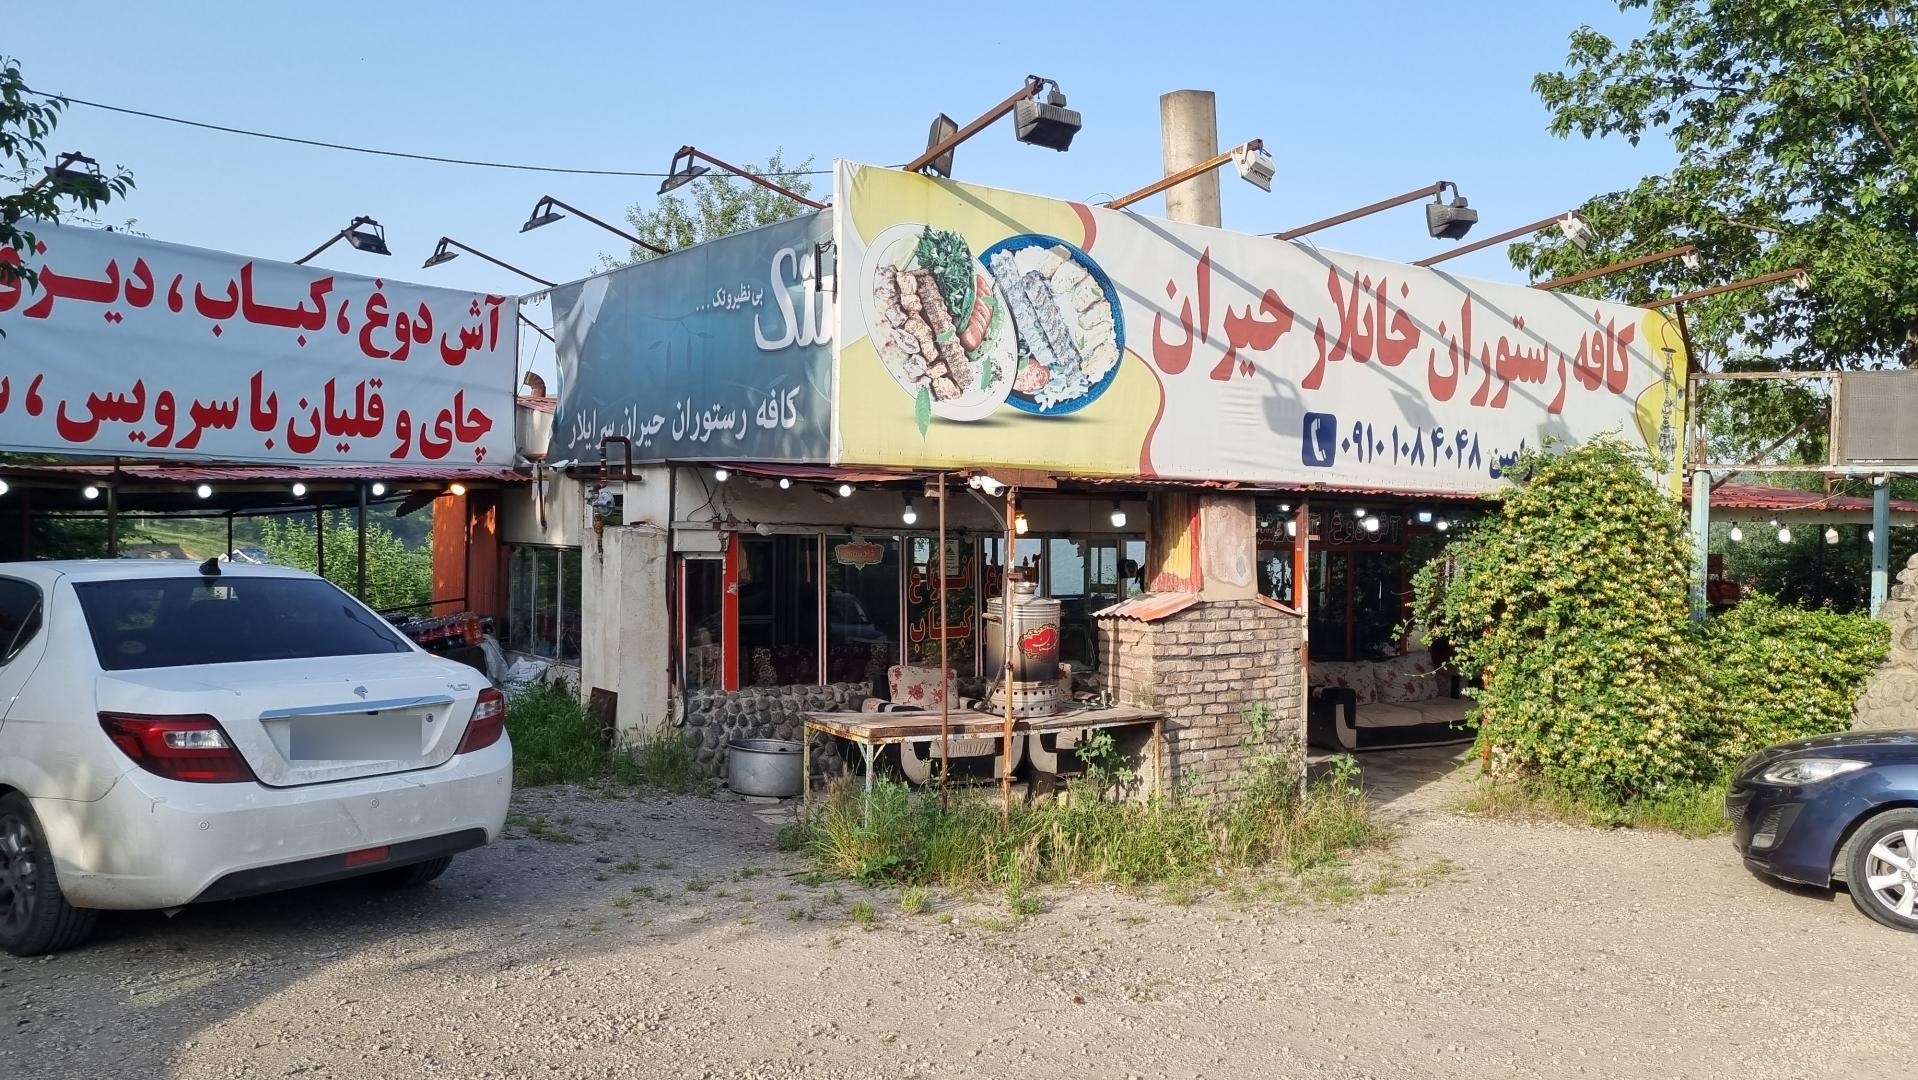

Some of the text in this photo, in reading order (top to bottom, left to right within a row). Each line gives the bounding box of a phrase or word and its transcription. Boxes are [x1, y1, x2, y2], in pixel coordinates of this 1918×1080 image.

[440, 295, 506, 365] آش
[1152, 246, 1636, 414] کافه رستوران خانلار حیران
[250, 371, 278, 450] با
[287, 377, 385, 453] قلیان
[390, 404, 412, 459] و
[419, 388, 493, 463] چای
[620, 402, 666, 447] حیران
[671, 395, 747, 443] رستوران
[755, 384, 801, 430] کافه
